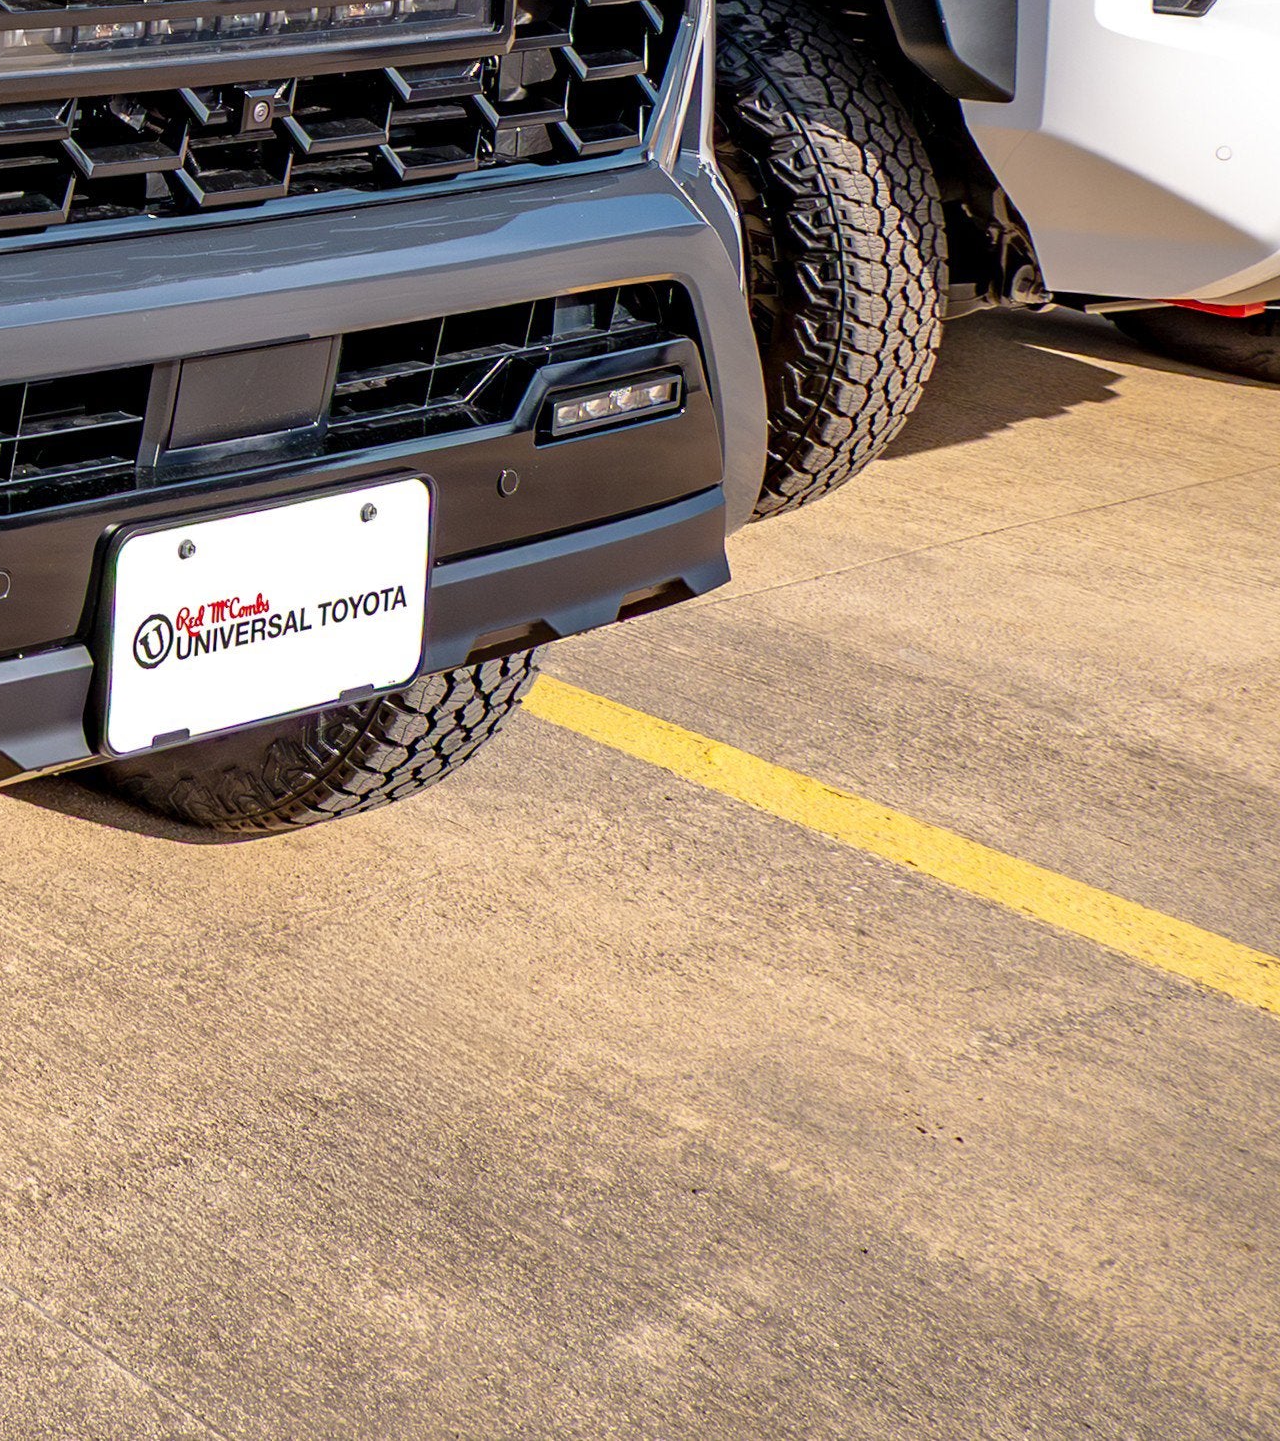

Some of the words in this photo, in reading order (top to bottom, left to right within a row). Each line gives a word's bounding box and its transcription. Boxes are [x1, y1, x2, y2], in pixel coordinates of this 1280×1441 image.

[176, 605, 204, 637] Red
[207, 593, 269, 624] McCombs
[176, 607, 312, 660] UNIVERSAL
[318, 585, 407, 626] TOYOTA
